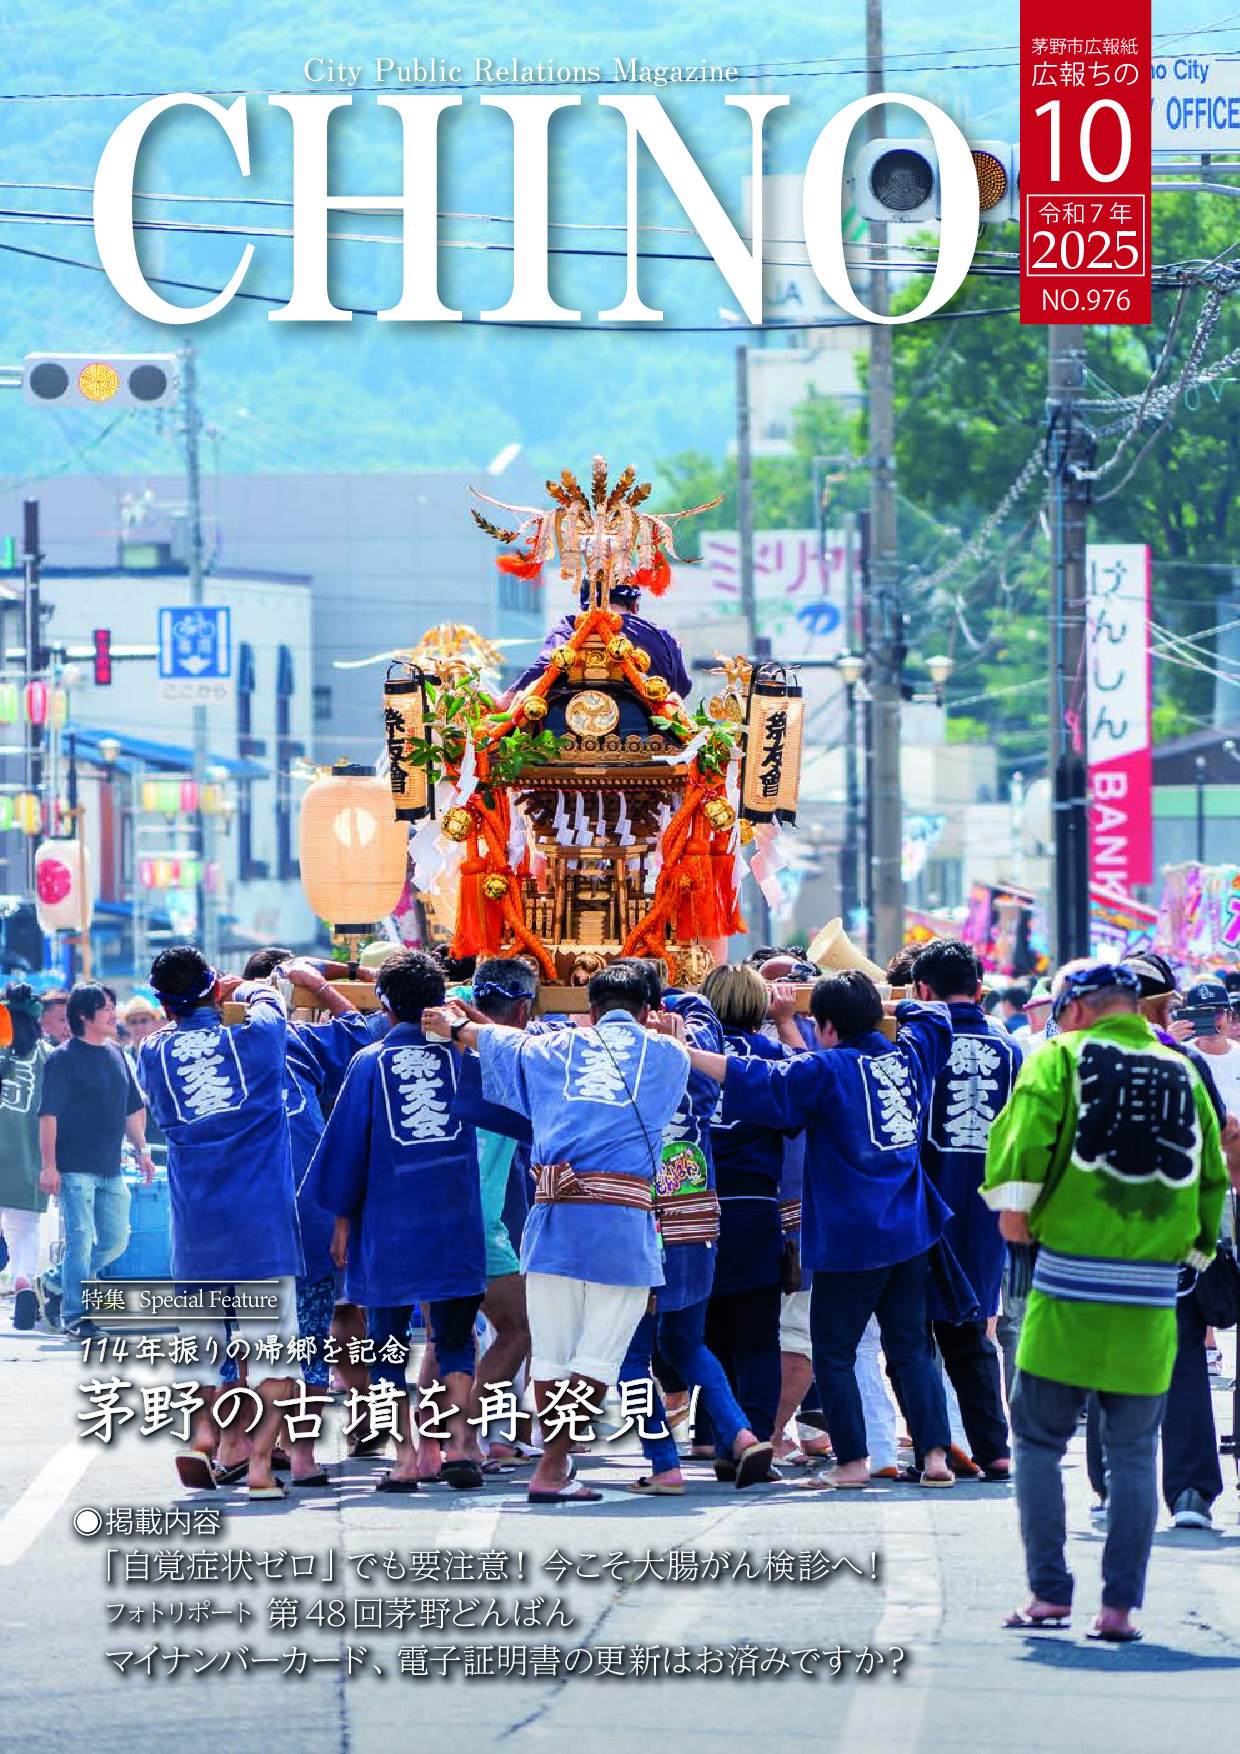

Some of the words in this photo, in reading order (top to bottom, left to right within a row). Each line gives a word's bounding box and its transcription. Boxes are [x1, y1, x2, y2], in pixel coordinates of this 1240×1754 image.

[1174, 59, 1209, 84] City
[1166, 95, 1240, 130] OFFICE
[1090, 559, 1128, 741] けんしん
[1093, 771, 1129, 898] BANK
